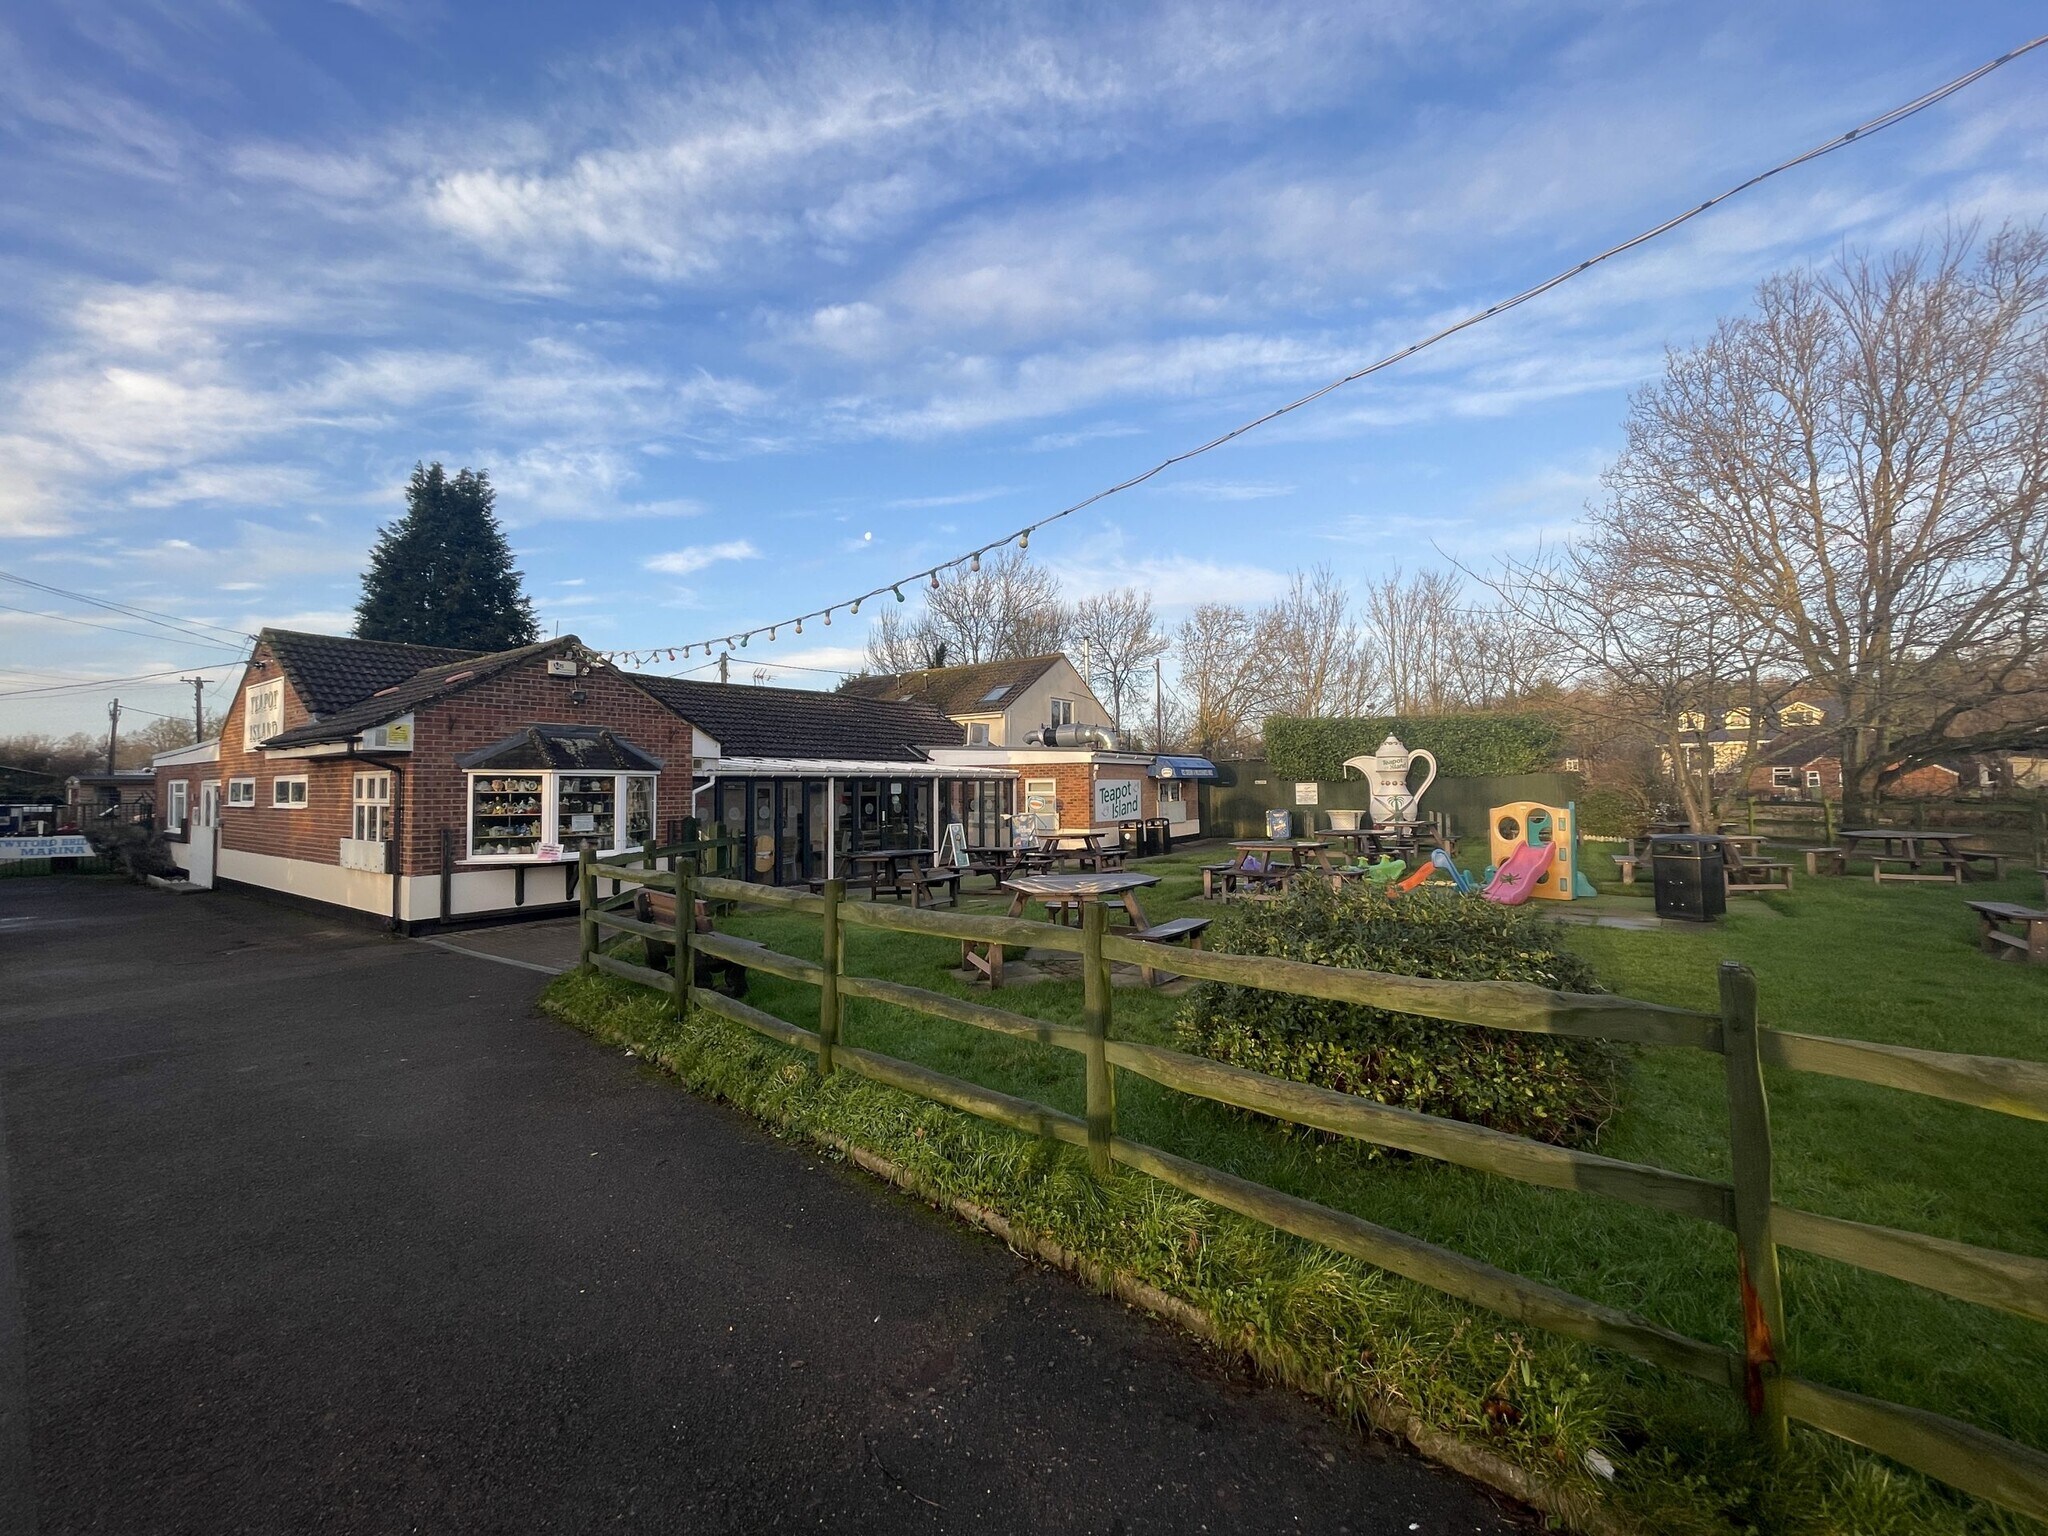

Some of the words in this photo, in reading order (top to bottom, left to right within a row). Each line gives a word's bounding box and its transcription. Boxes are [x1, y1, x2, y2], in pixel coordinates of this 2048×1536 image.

[250, 690, 279, 714] TEAPOT
[249, 721, 278, 742] ISLAND
[1099, 781, 1131, 805] Teapot
[1112, 795, 1138, 819] Island
[20, 846, 86, 856] MARINA
